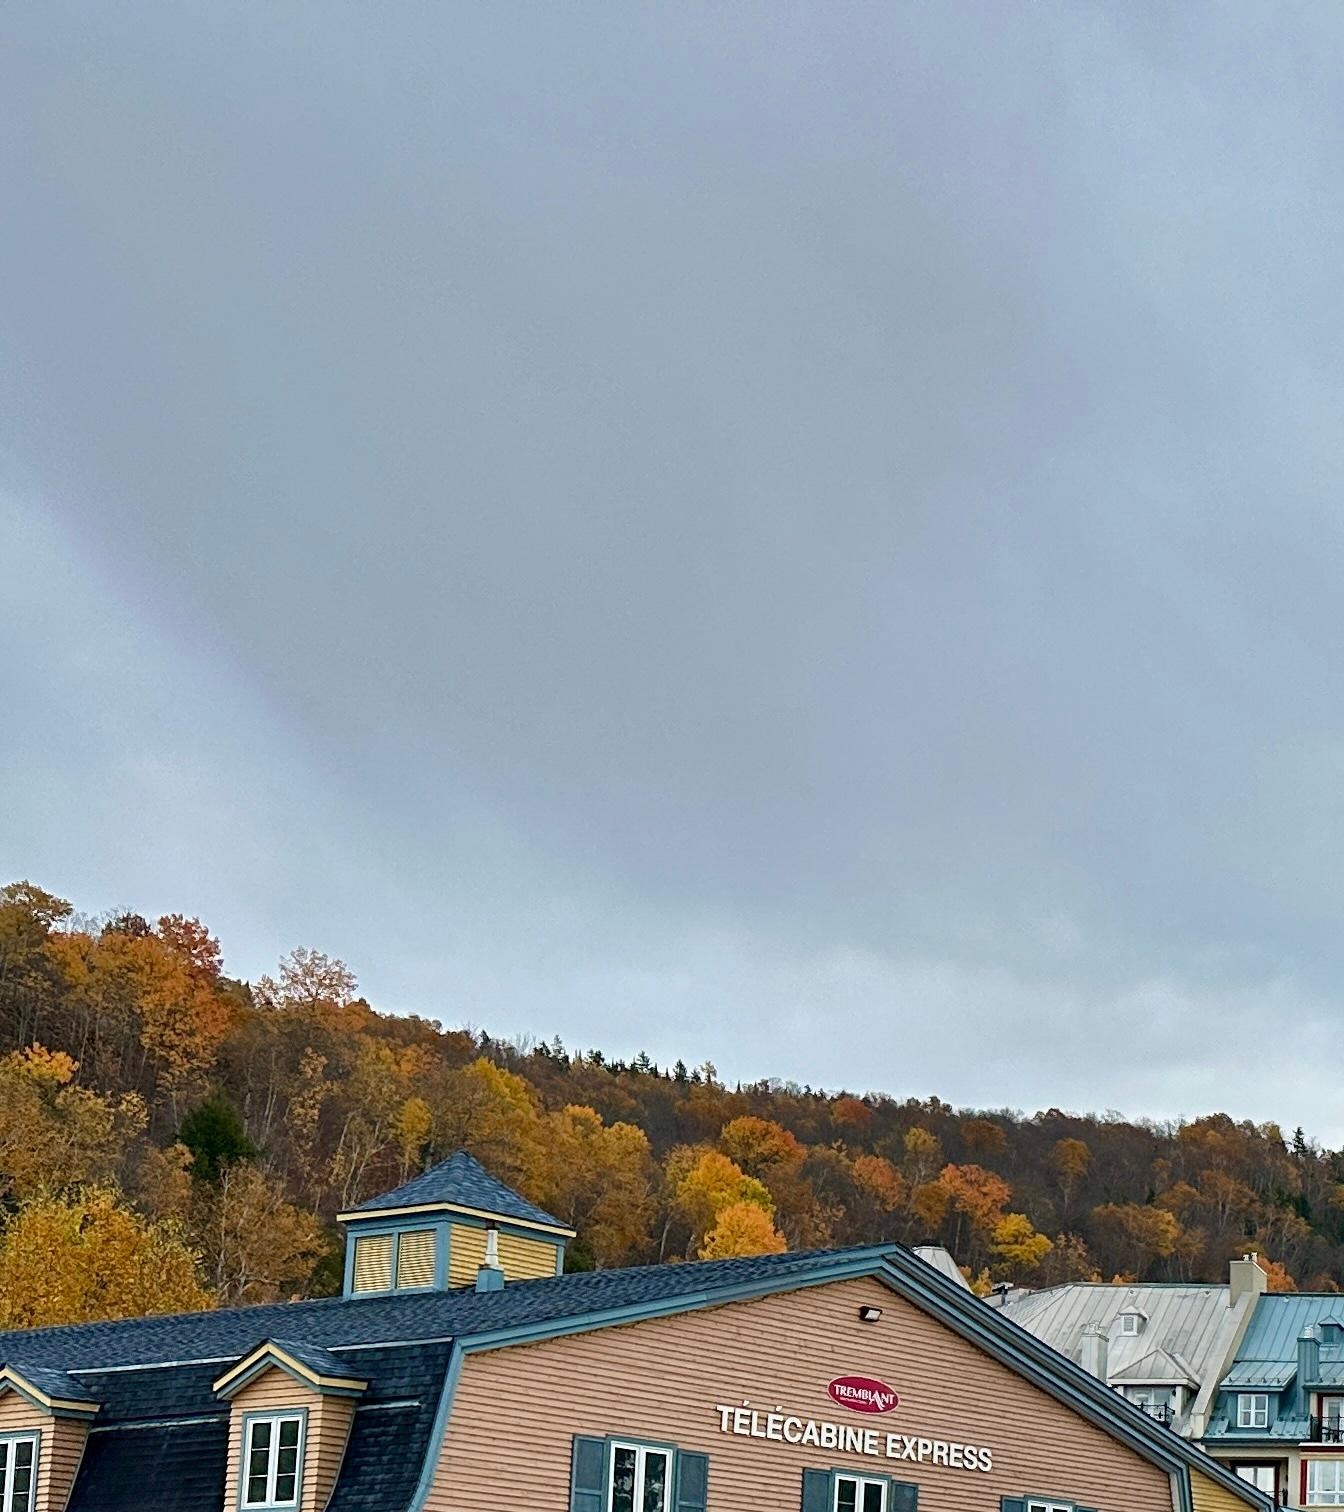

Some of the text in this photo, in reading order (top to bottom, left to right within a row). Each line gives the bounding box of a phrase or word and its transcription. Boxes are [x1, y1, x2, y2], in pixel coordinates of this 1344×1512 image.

[834, 1384, 895, 1410] TREMBLANT
[716, 1400, 993, 1472] TÉLÉCABINE EXPRESS
